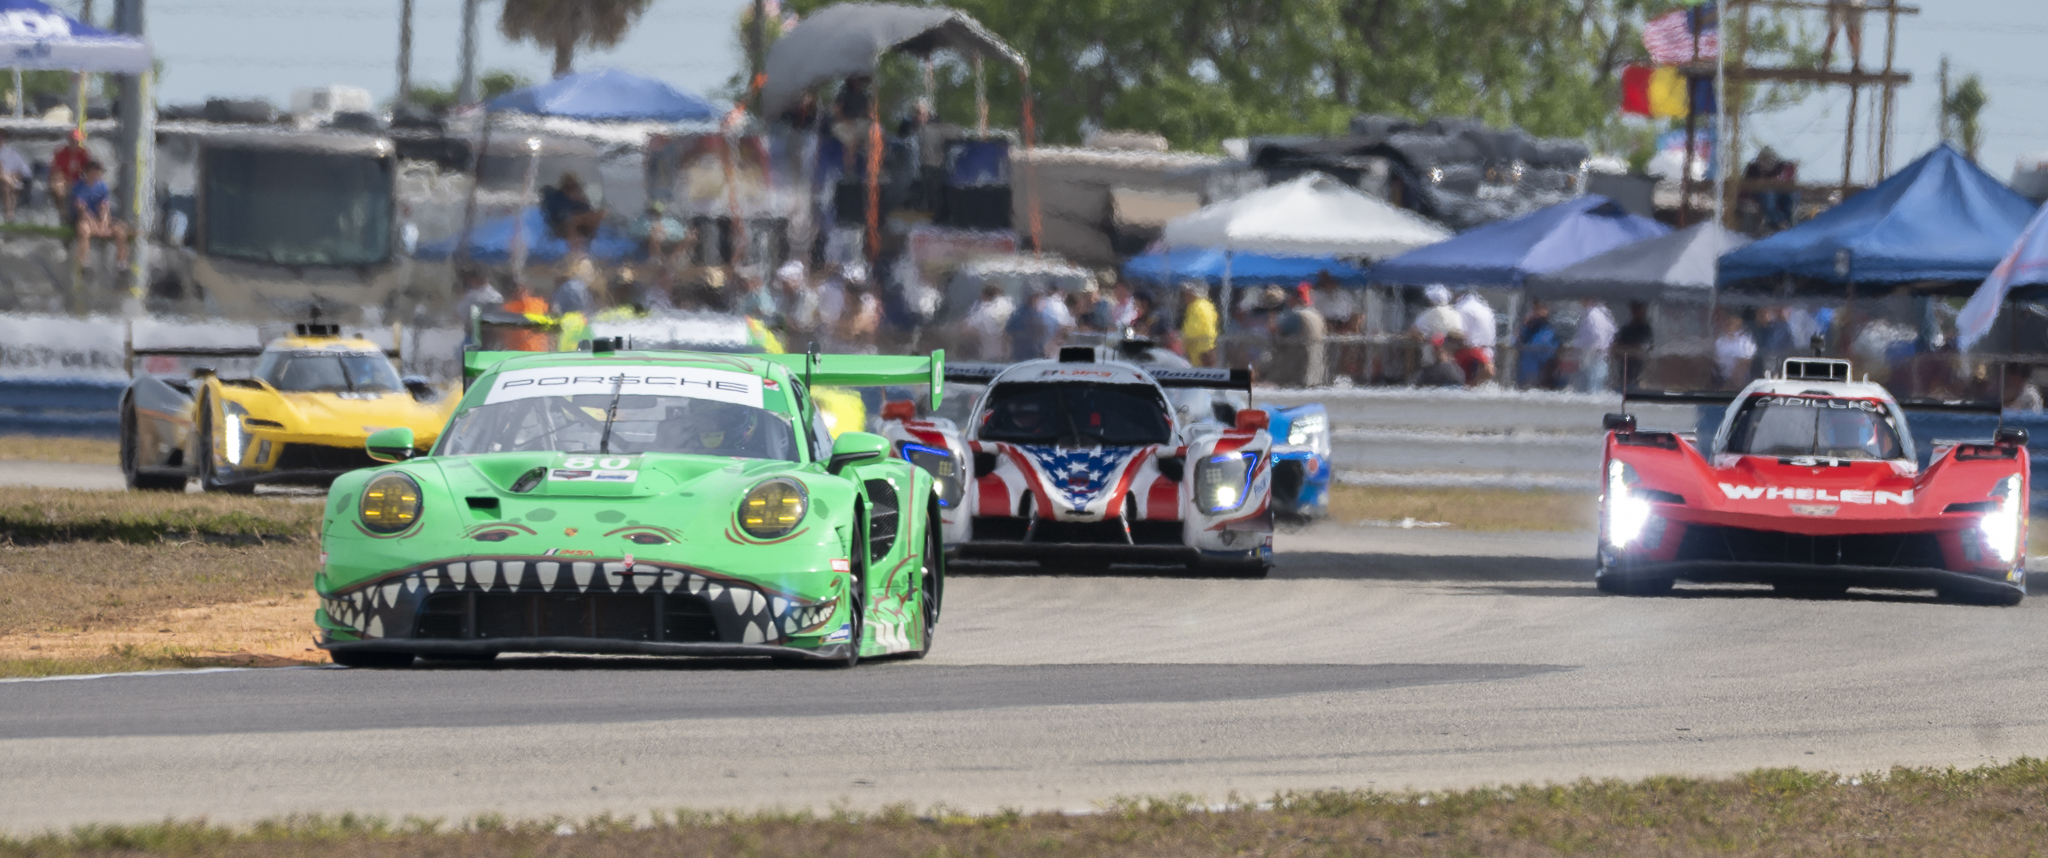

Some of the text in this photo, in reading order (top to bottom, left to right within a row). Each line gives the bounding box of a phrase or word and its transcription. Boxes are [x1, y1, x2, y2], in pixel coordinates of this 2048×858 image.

[501, 375, 749, 394] PORSCHE
[1755, 396, 1877, 412] CADILLAC
[562, 457, 631, 469] 80
[1718, 482, 1914, 505] WHELEN
